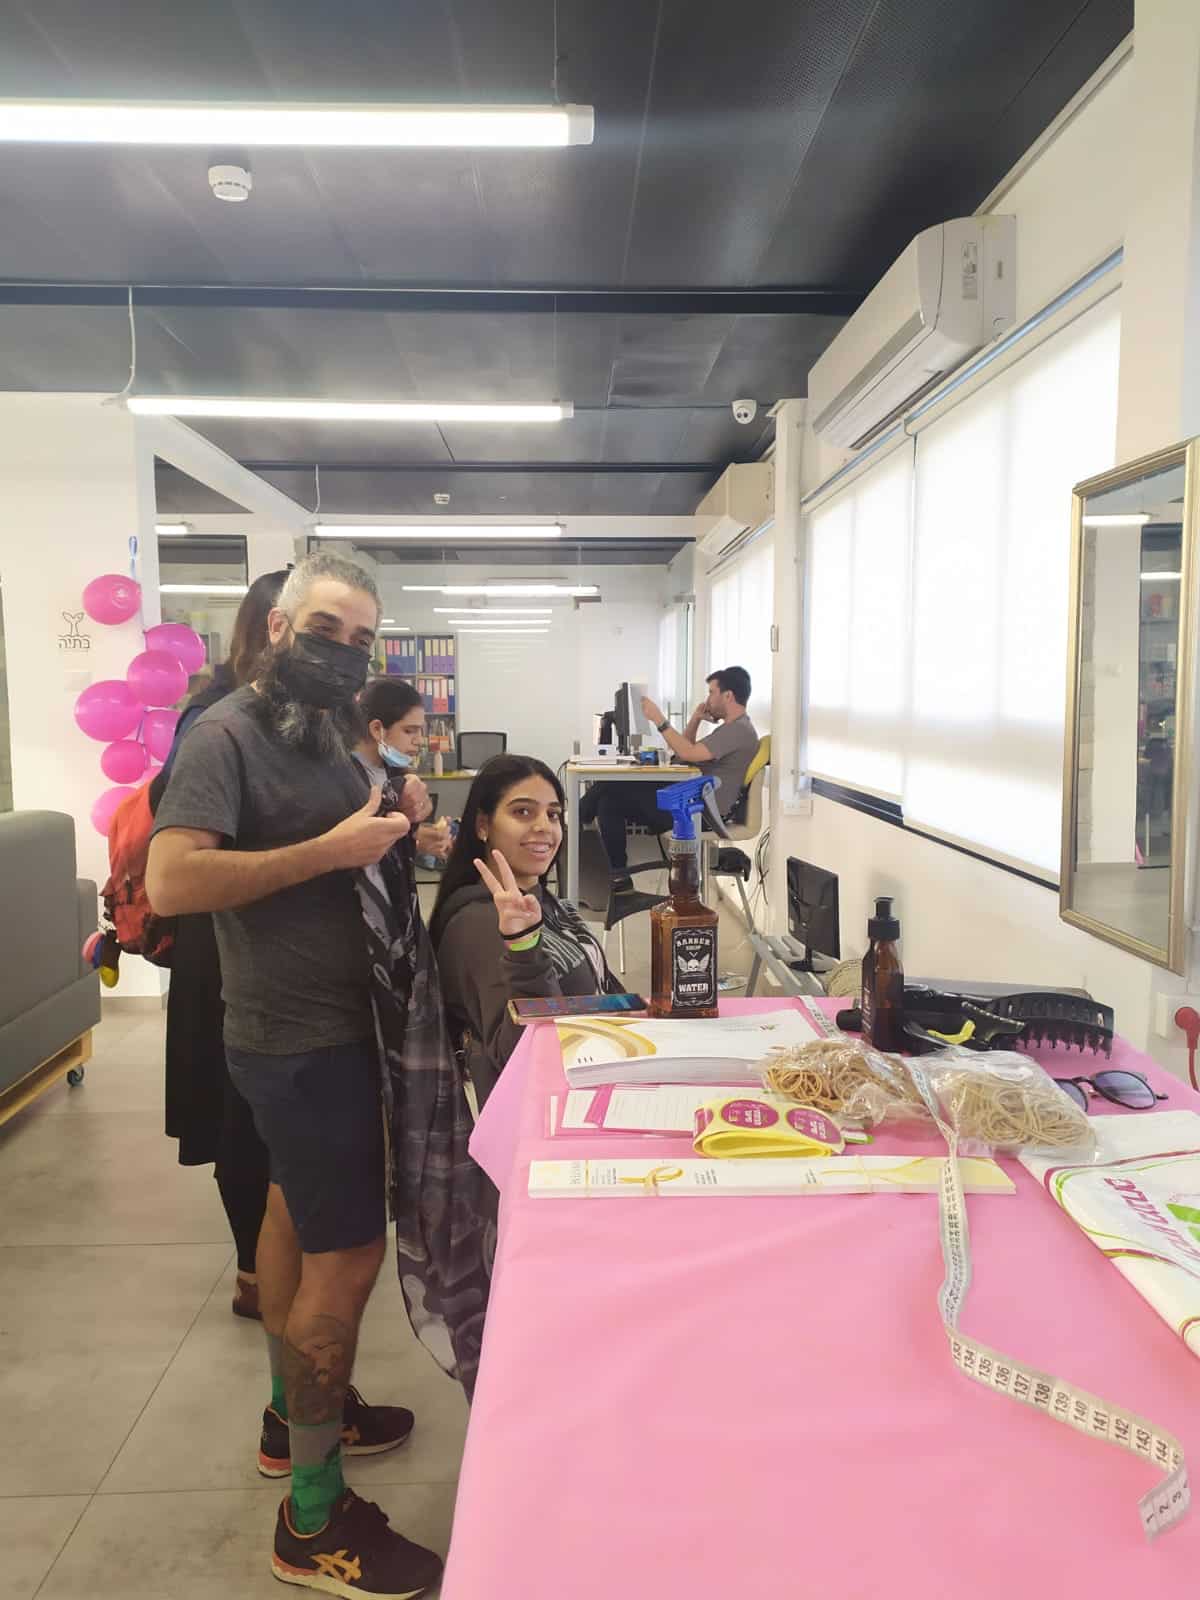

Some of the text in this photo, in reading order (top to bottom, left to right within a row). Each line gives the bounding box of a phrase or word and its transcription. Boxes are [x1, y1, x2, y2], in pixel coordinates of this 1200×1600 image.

[676, 938, 710, 947] BARBER
[678, 984, 708, 993] WATER
[963, 1349, 976, 1369] 134
[978, 1357, 992, 1377] 135
[994, 1365, 1010, 1386] 136
[1013, 1373, 1030, 1396] 137
[1034, 1383, 1051, 1405] 138
[1054, 1391, 1069, 1413] 139
[1073, 1400, 1088, 1423] 140
[1092, 1410, 1108, 1432] 141
[1114, 1418, 1129, 1441] 142
[1135, 1429, 1151, 1451] 143
[1155, 1439, 1168, 1463] 144
[1159, 1502, 1169, 1514] 2
